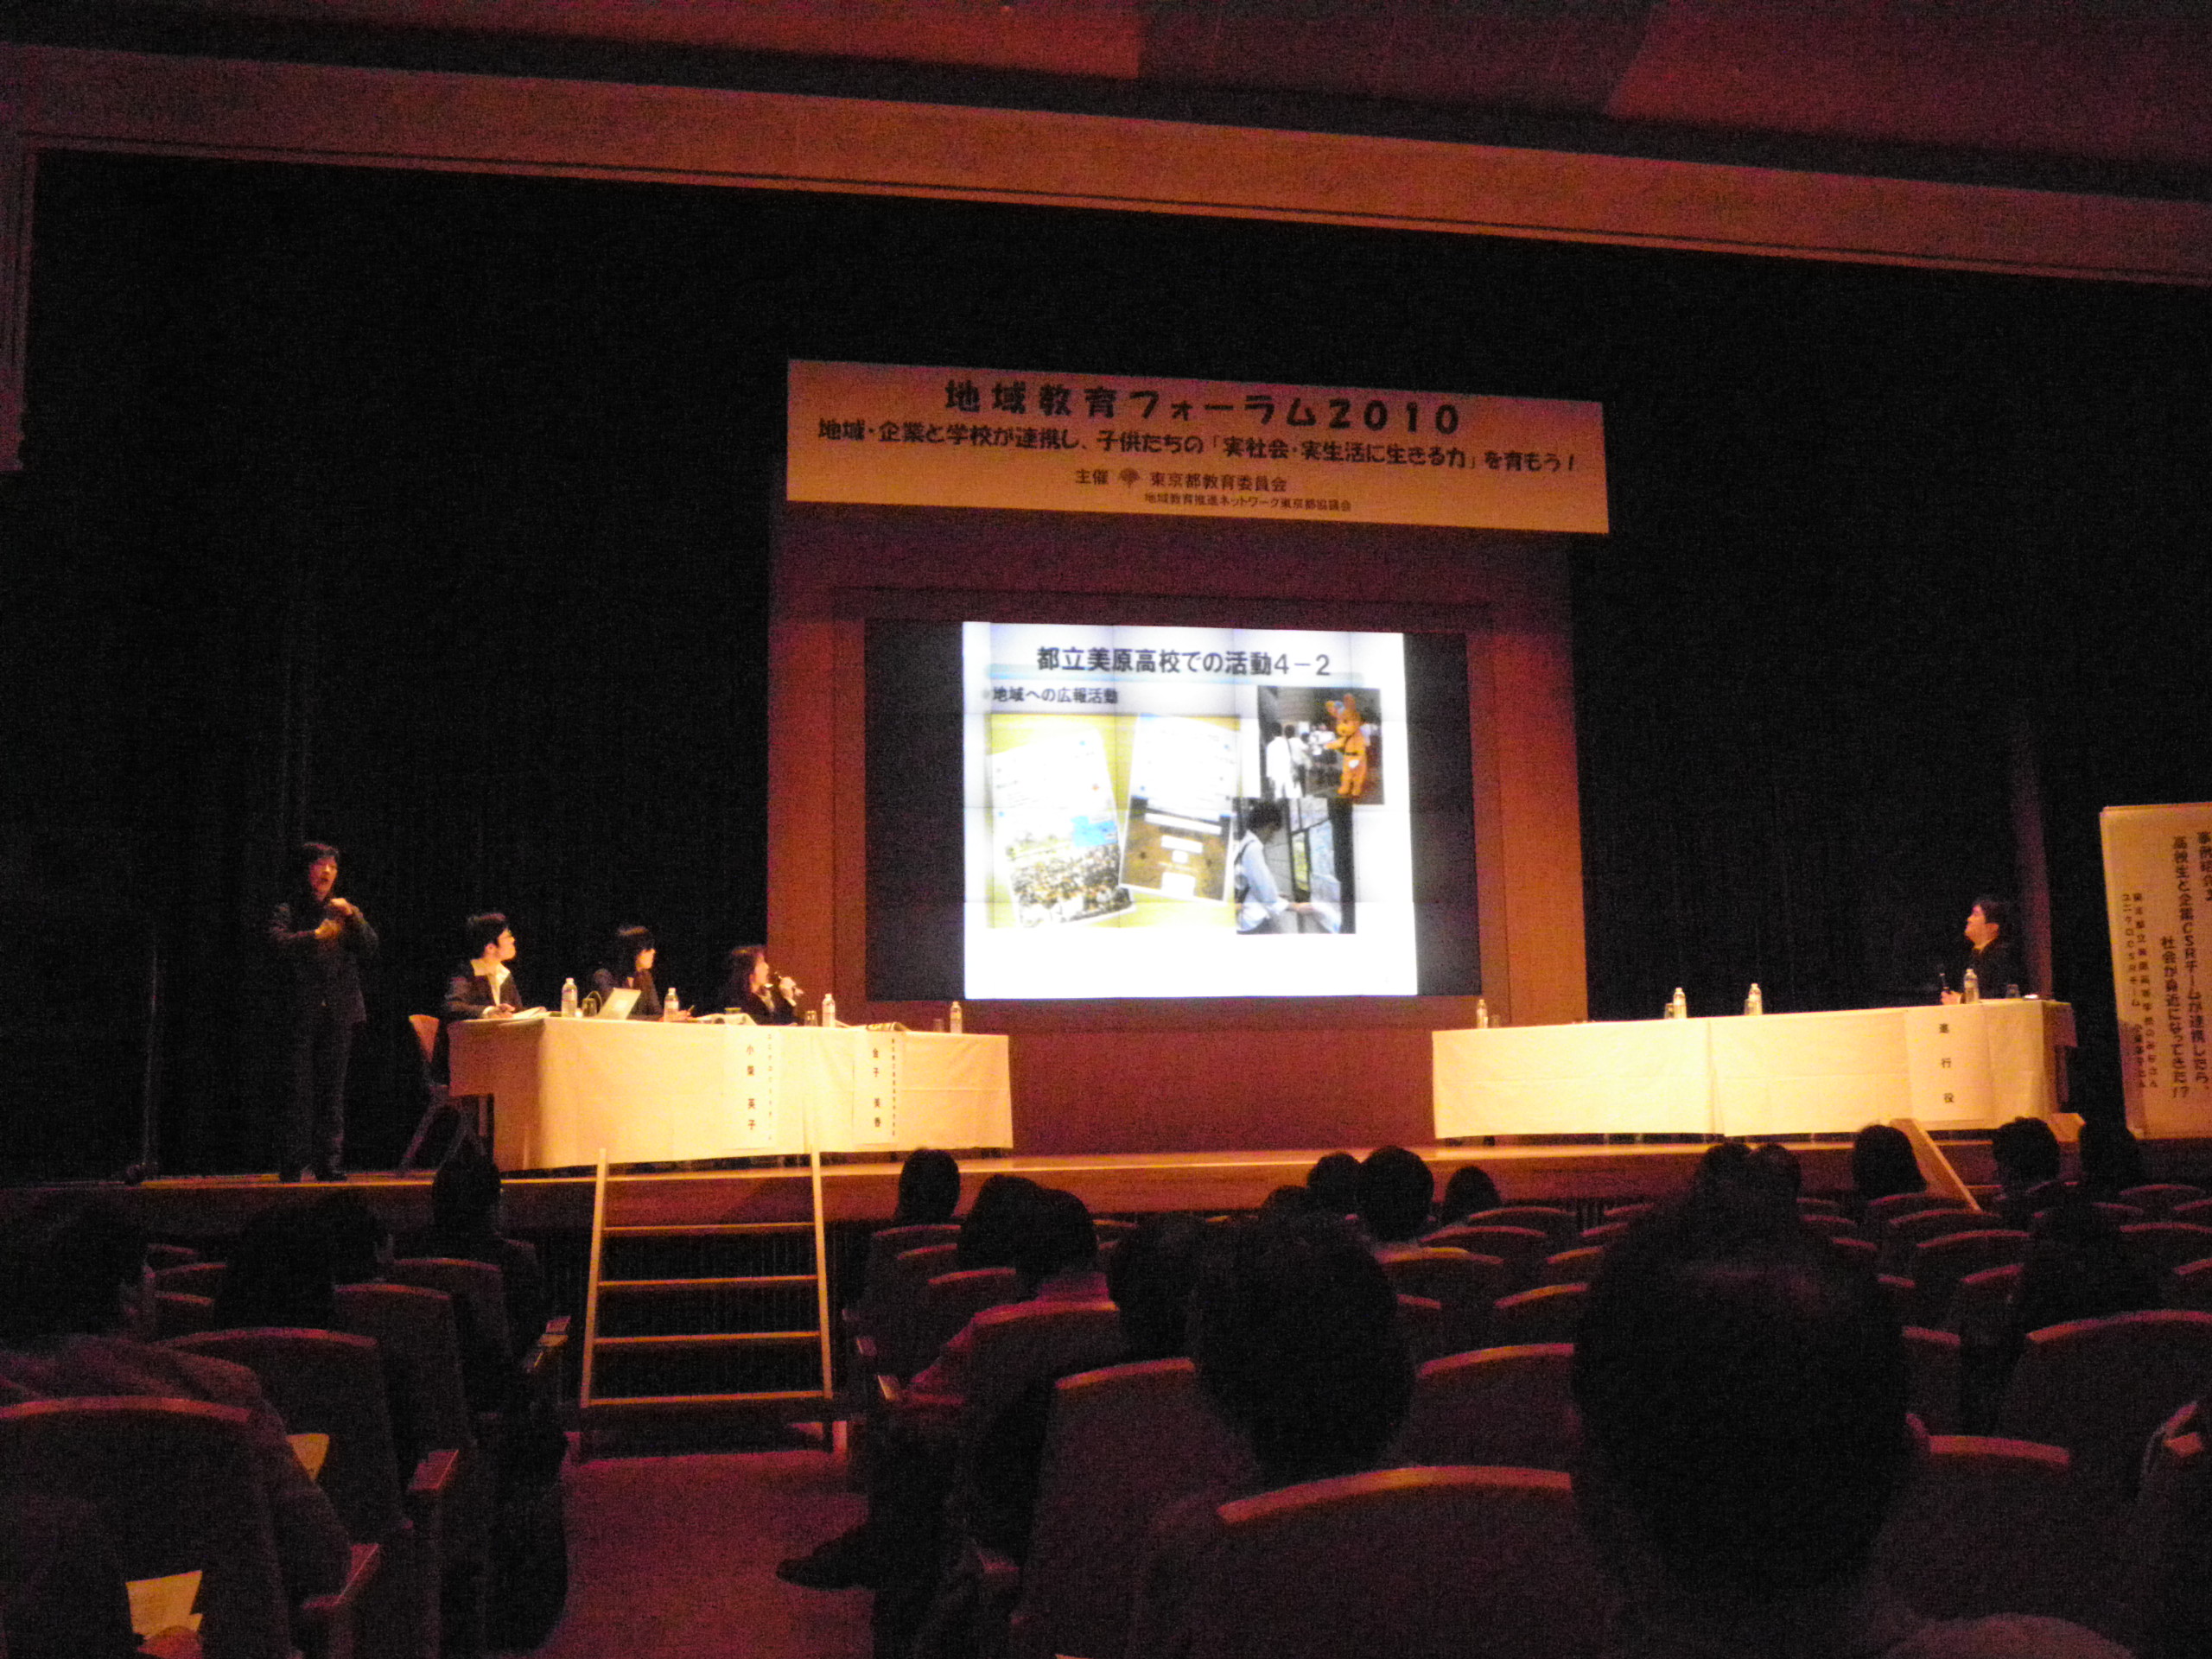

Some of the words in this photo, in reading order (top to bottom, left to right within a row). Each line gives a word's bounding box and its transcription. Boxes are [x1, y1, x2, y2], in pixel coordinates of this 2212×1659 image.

[945, 379, 1459, 434] 地域教育フォーラム2010
[1075, 467, 1109, 485] 主催
[1150, 471, 1287, 493] 東京都教育委員会
[992, 685, 1119, 704] 地域への広報活動
